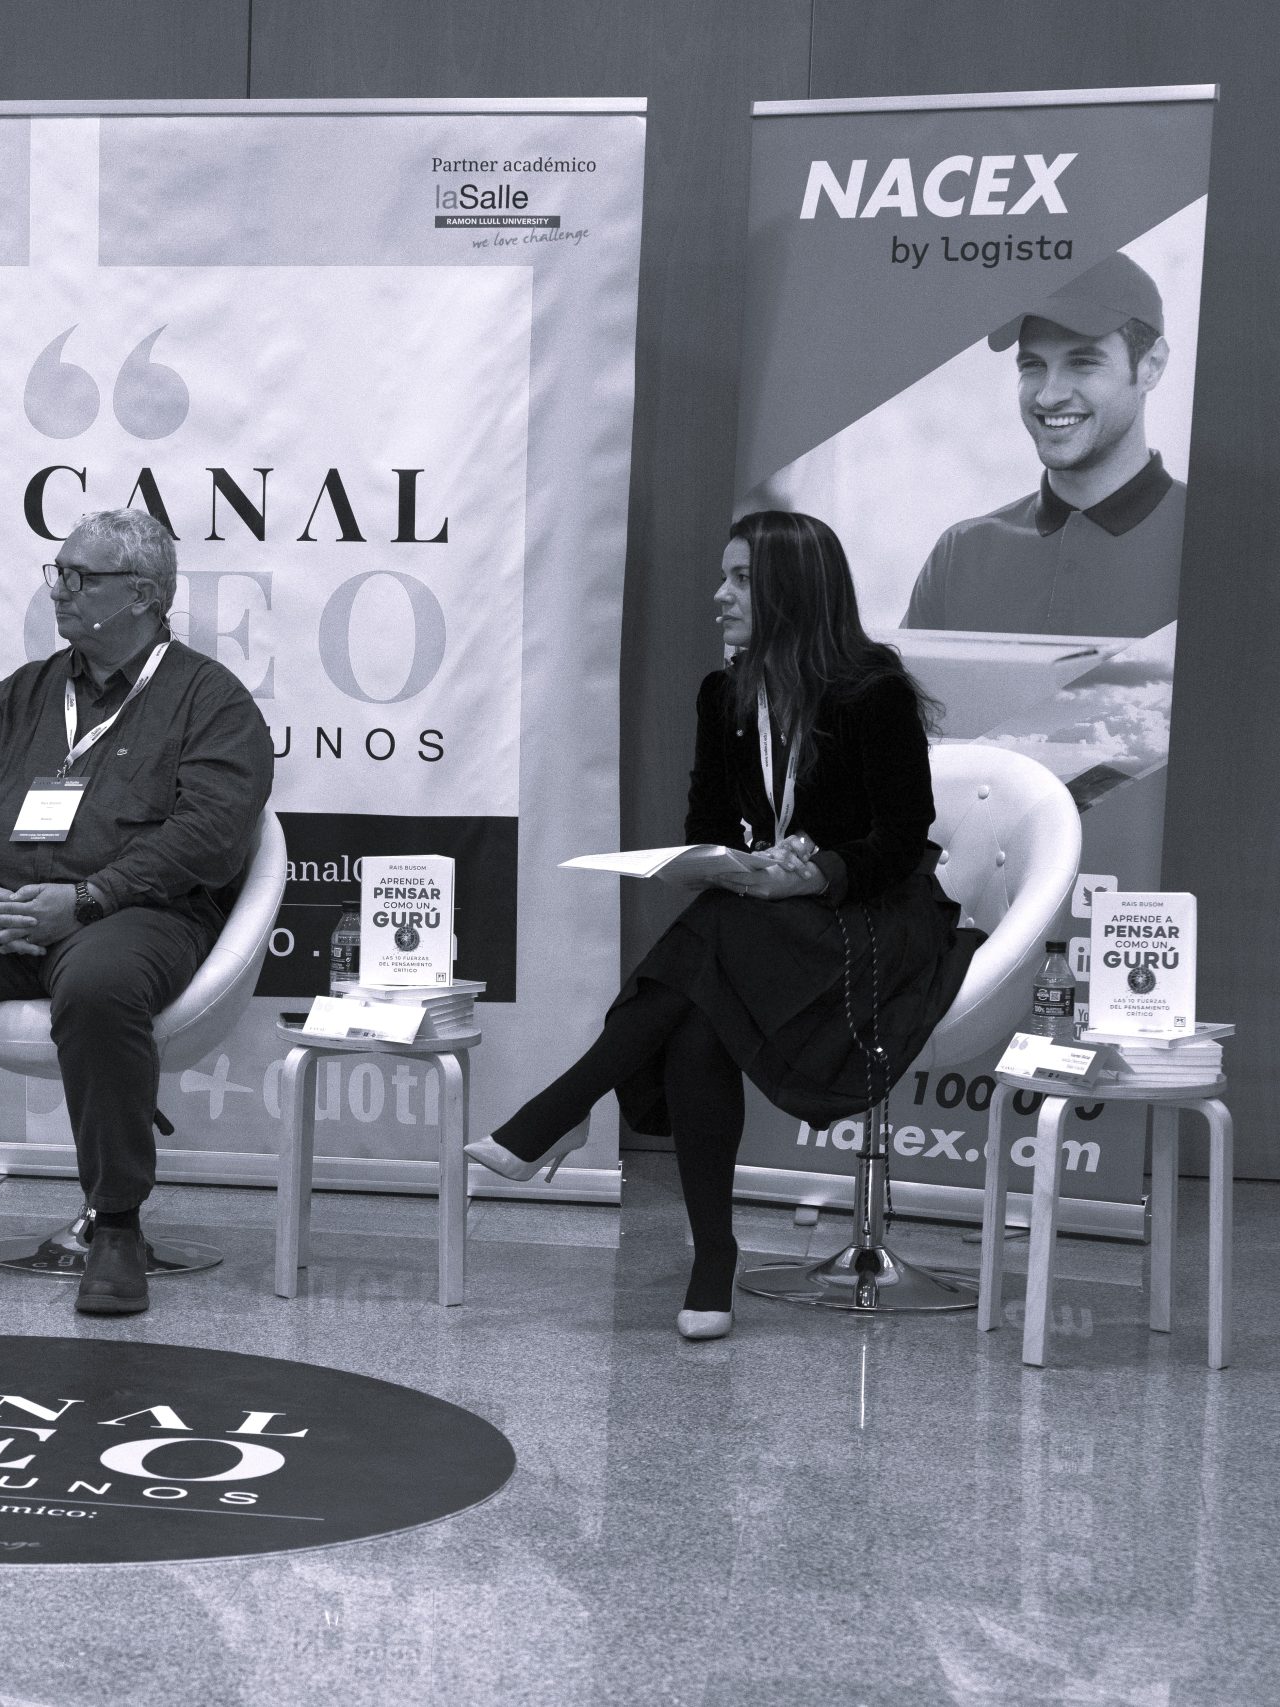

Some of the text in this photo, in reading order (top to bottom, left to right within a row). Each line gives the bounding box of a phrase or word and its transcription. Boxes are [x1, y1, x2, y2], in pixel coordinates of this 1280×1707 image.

[432, 157, 596, 172] Partner académico
[436, 184, 528, 209] laSalle
[800, 153, 1078, 219] NACEX
[472, 227, 591, 248] we love challenge
[891, 234, 1073, 269] by logista
[23, 465, 449, 543] CANAL
[23, 570, 446, 704] EO
[374, 887, 440, 899] PENSAR
[373, 907, 440, 928] GURÚ
[1112, 915, 1162, 923] APRENDE
[1104, 925, 1180, 938] PENSAR
[1103, 946, 1179, 969] GURÚ
